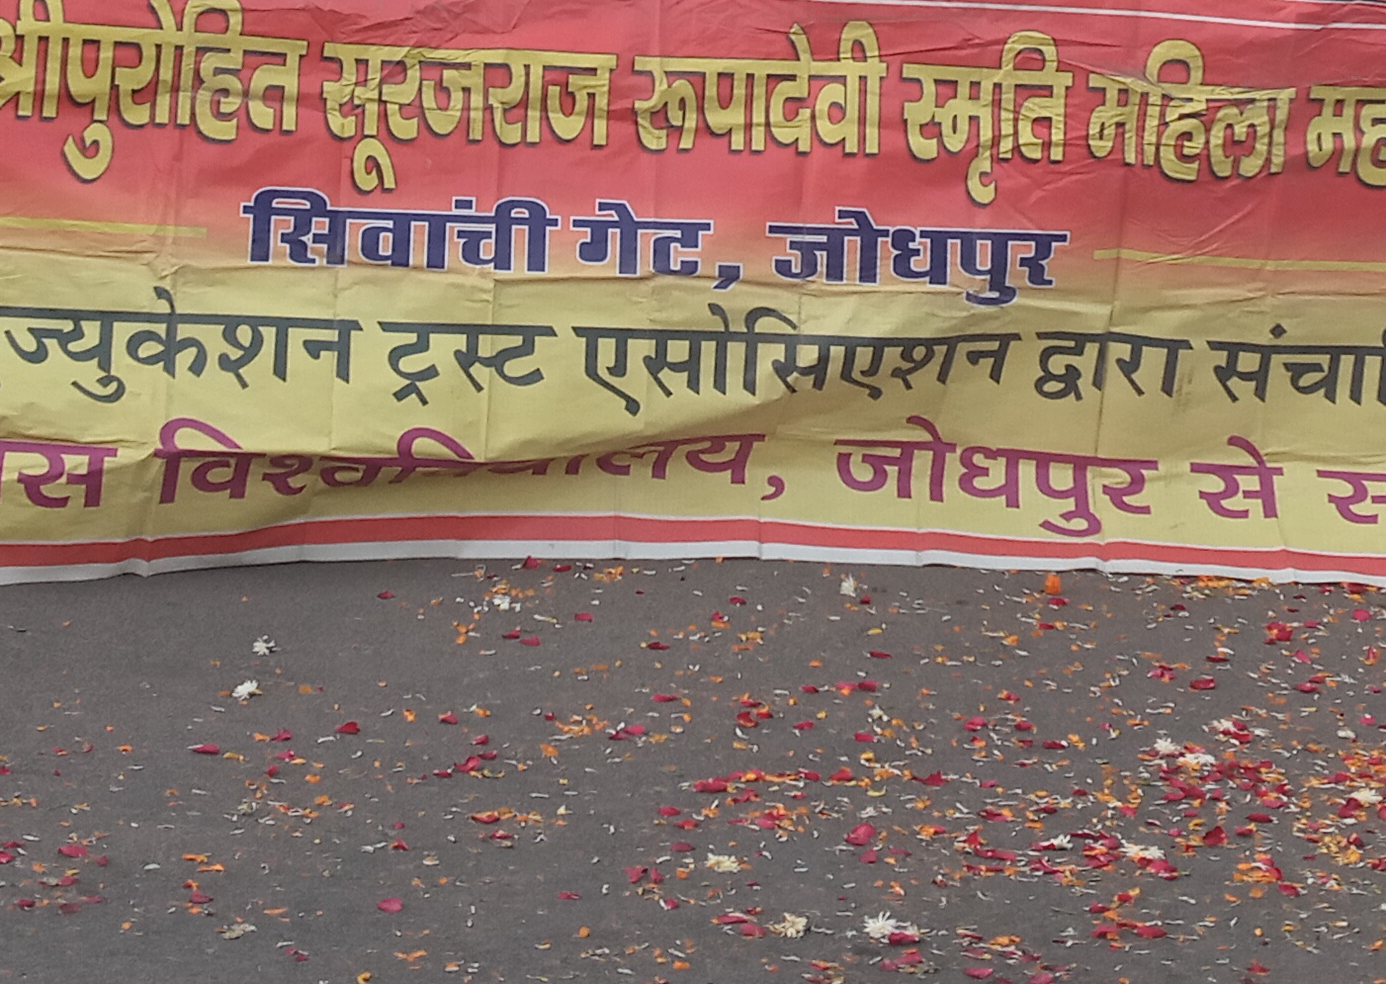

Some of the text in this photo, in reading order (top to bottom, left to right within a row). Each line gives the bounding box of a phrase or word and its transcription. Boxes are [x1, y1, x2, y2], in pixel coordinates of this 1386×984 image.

[322, 41, 618, 193] सूरजराज
[633, 20, 887, 156] रूपादेवी
[902, 30, 1074, 206] स्मृति
[1087, 38, 1296, 182] महिला
[239, 186, 561, 274] सिवांची
[765, 206, 1071, 305] जोधपुर
[375, 319, 558, 408] ट्रस्ट
[572, 302, 1022, 417] एसोसिएशन
[1034, 330, 1193, 401] द्वारा
[834, 415, 1159, 538] जोधपुर
[1190, 434, 1284, 521] से
